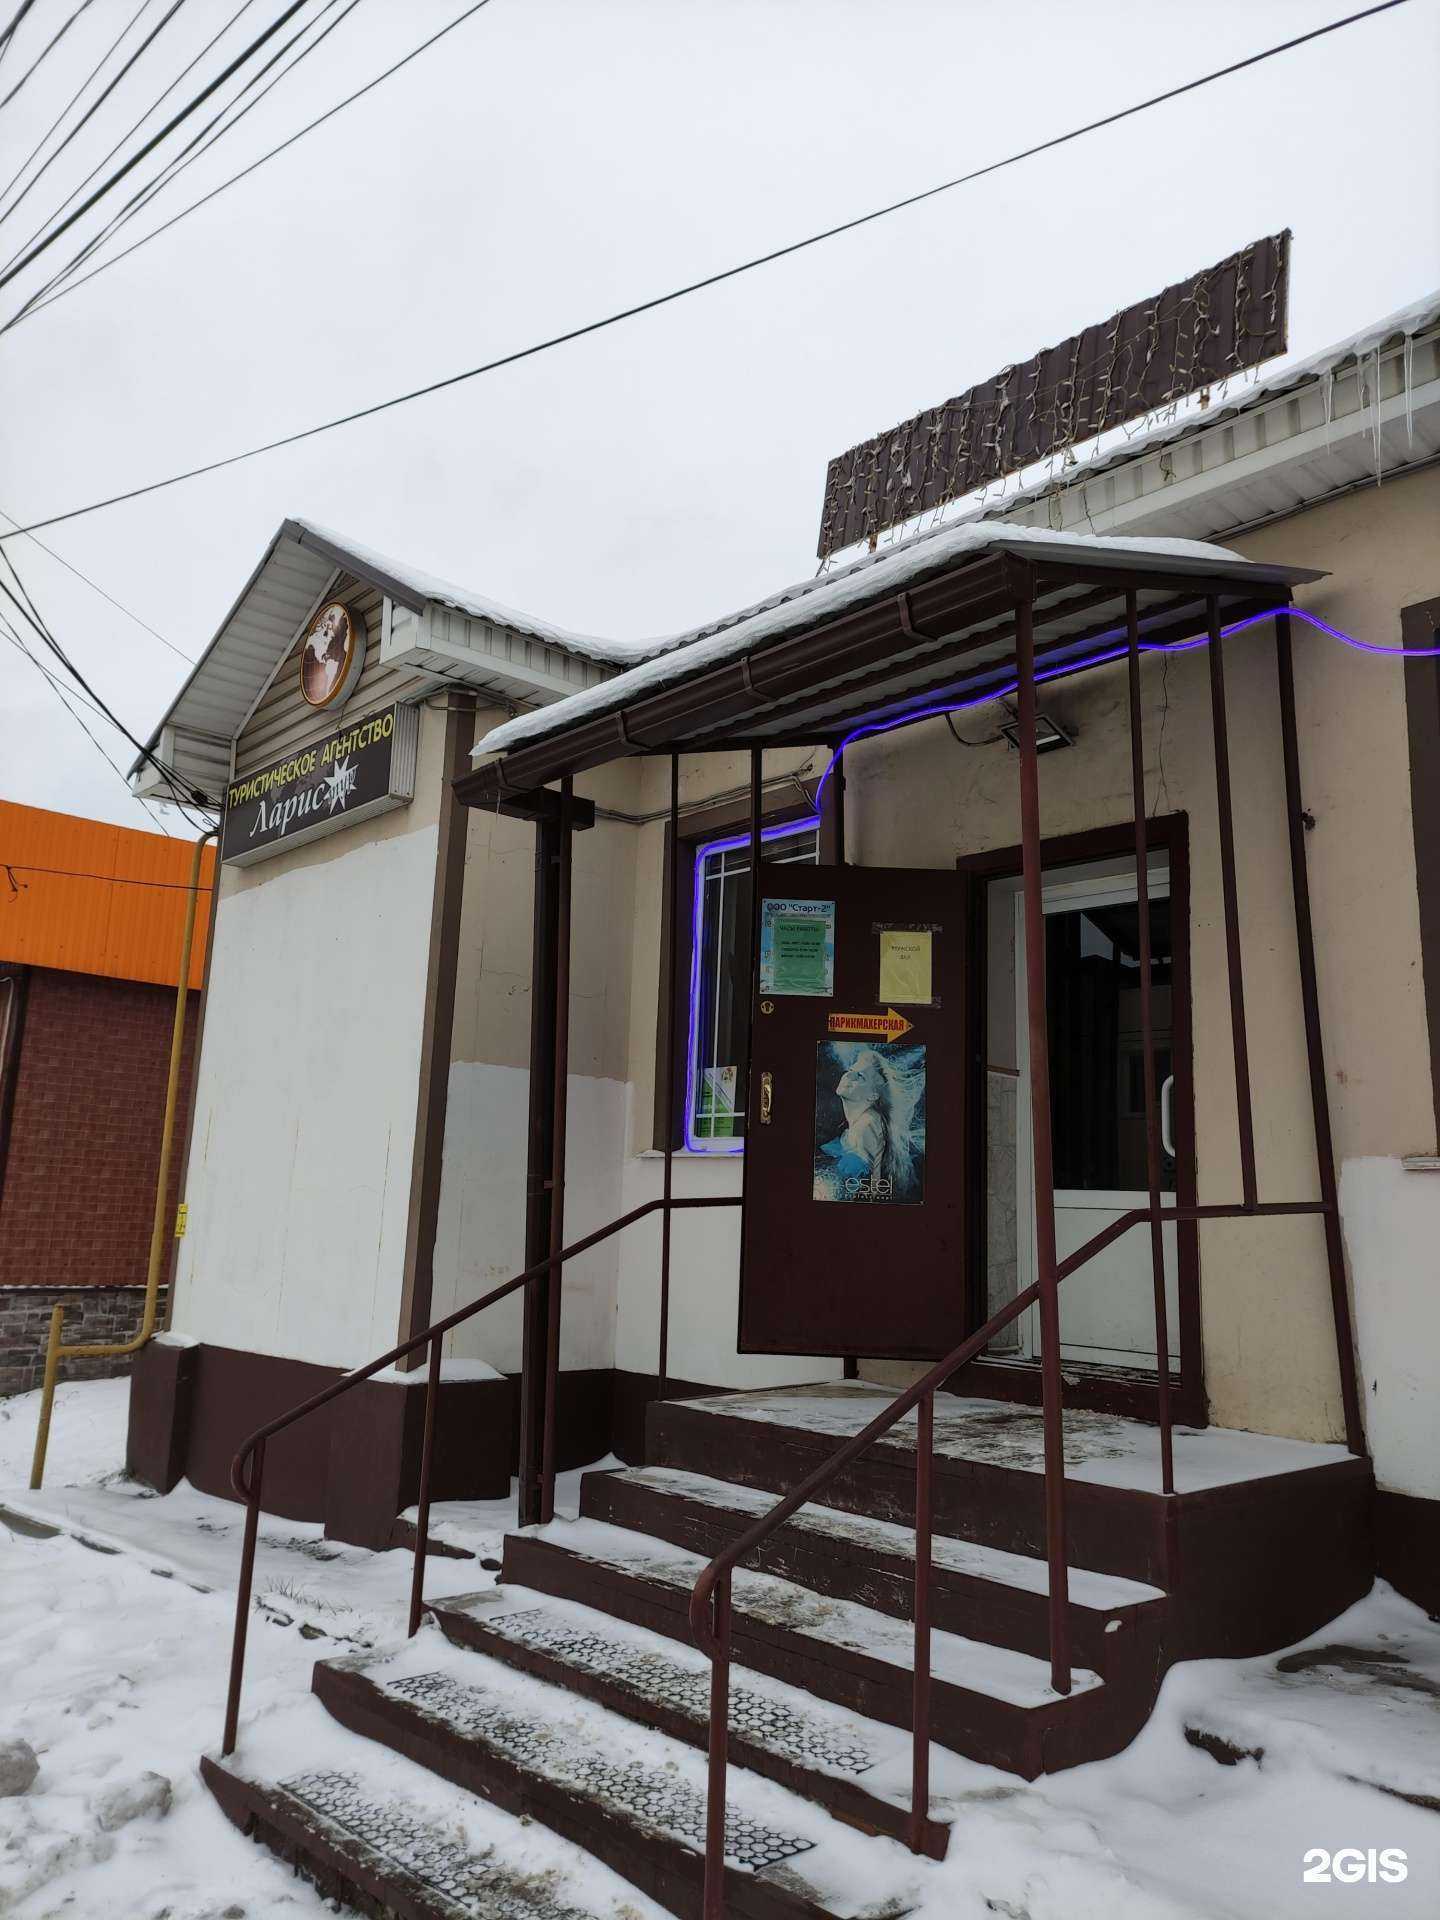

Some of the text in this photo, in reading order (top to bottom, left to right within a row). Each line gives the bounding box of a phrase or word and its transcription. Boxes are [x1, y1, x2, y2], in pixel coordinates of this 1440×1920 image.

[228, 713, 394, 809] ТУРИСТИЧЕСКОЕ АГЕНТСТВО
[828, 1015, 905, 1031] ПАРИКМАХЕРСКАЯ
[845, 1174, 893, 1193] estel
